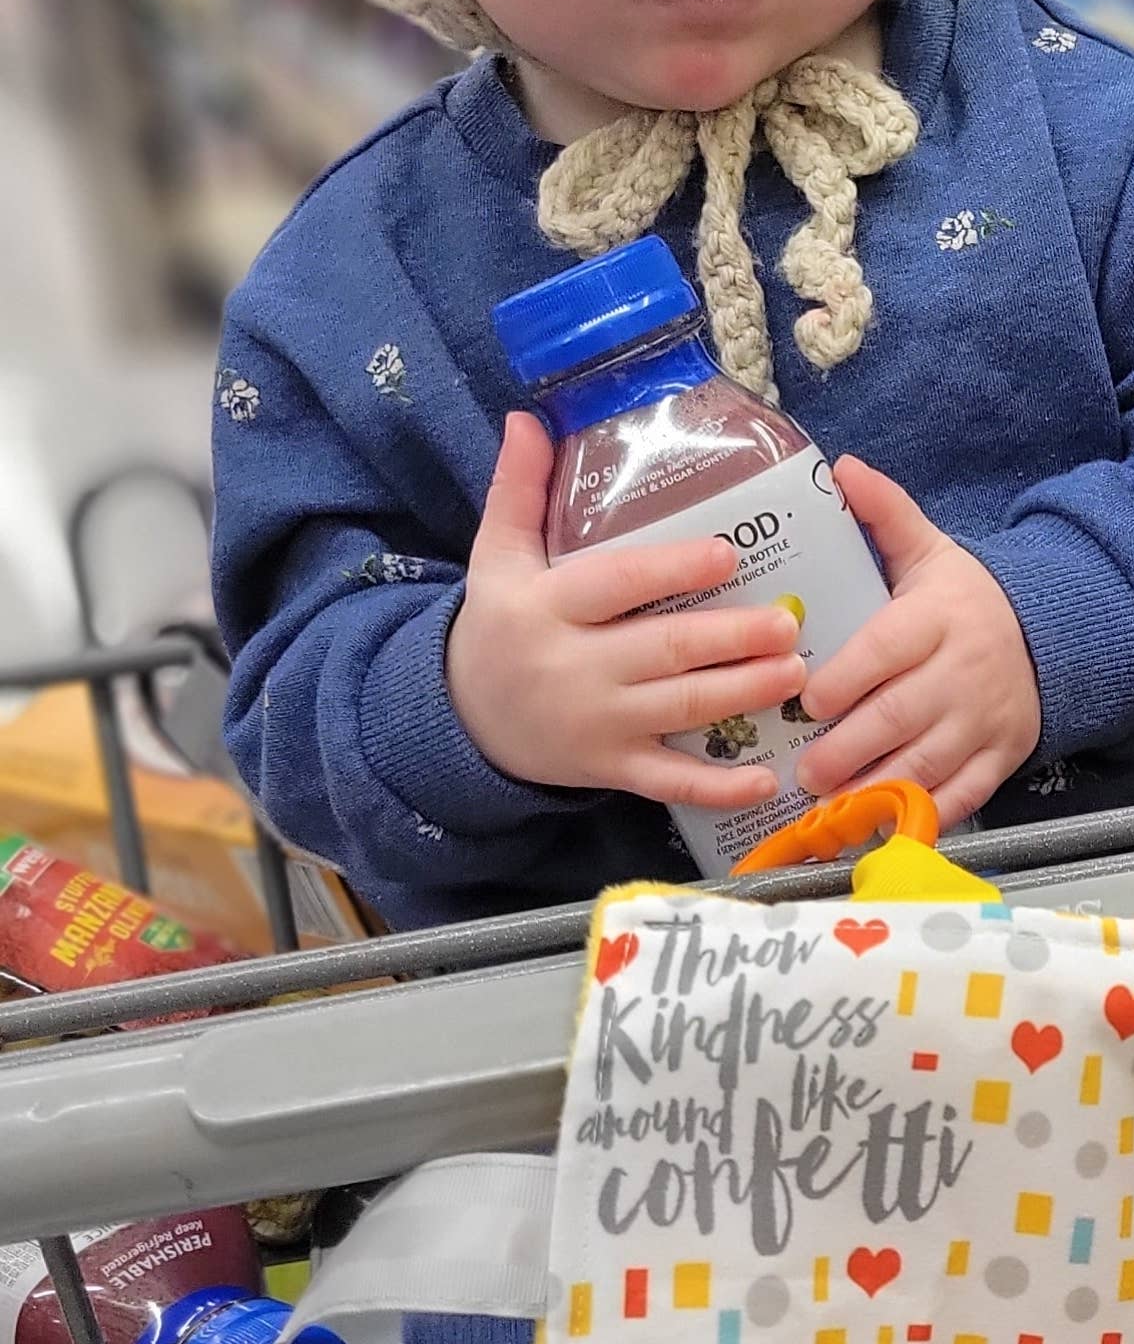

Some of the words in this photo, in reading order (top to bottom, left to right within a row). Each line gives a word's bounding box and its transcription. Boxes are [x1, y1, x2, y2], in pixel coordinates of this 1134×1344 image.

[609, 486, 647, 508] ALORIE
[660, 466, 695, 488] SUGAR
[750, 538, 791, 565] BOTTLE
[675, 587, 721, 615] INCLUDES
[722, 577, 741, 594] THE
[741, 566, 766, 587] JUICE
[788, 738, 801, 750] 10
[734, 806, 764, 825] SERVING
[764, 794, 791, 813] EQUALS
[756, 795, 819, 828] RECOMMENDATIO
[576, 1089, 734, 1155] around
[790, 1053, 883, 1132] like
[598, 1097, 974, 1257] confetti
[176, 1220, 204, 1236] Keep
[102, 1231, 173, 1278] Refrigerated
[109, 1232, 212, 1290] PERISHABLE
